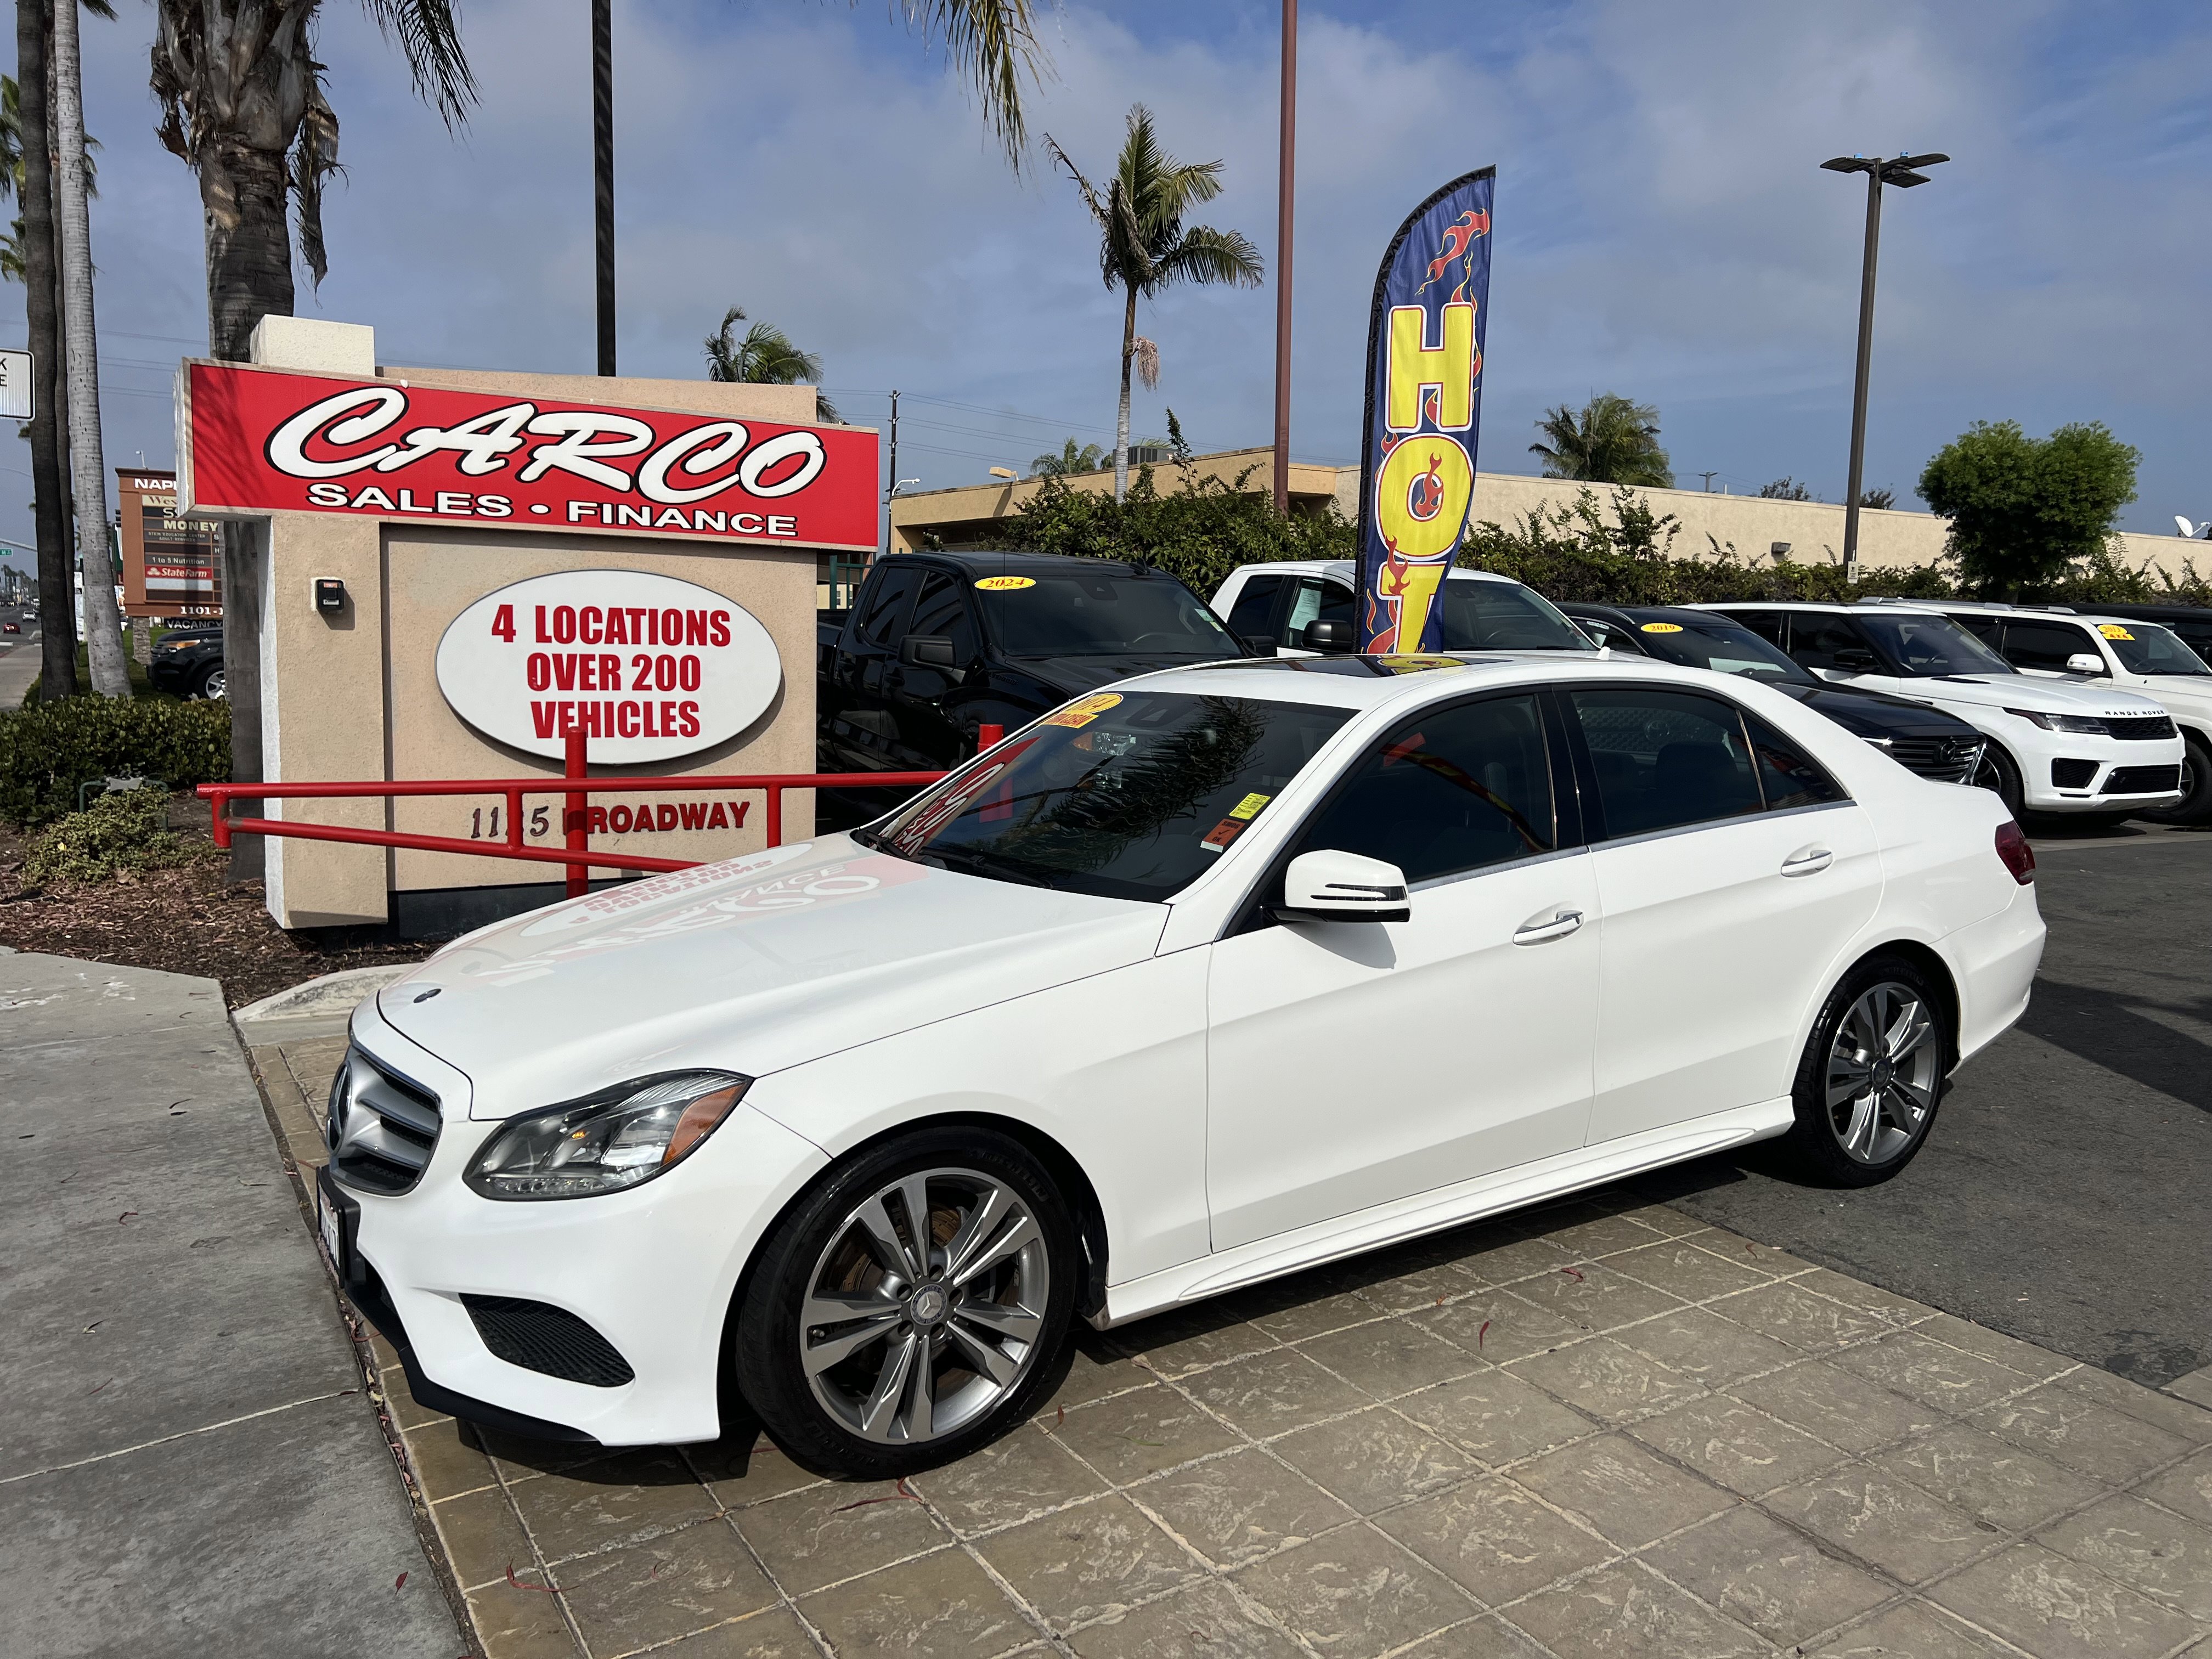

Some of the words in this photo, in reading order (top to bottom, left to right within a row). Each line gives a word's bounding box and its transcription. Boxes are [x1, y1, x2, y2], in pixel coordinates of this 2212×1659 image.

[264, 386, 827, 505] CARCO
[1375, 301, 1475, 654] HOT
[163, 520, 218, 532] MONEY
[306, 482, 514, 518] SALES
[566, 500, 799, 537] FINANCE
[985, 578, 1025, 588] 2024
[167, 619, 223, 629] VACANCY
[492, 604, 516, 642] 4
[534, 605, 731, 647] LOCATIONS
[527, 652, 621, 691] OVER
[631, 654, 701, 691] 200
[530, 700, 701, 739] VEHICLES
[471, 805, 549, 839] 115
[1221, 821, 1240, 829] SMOG
